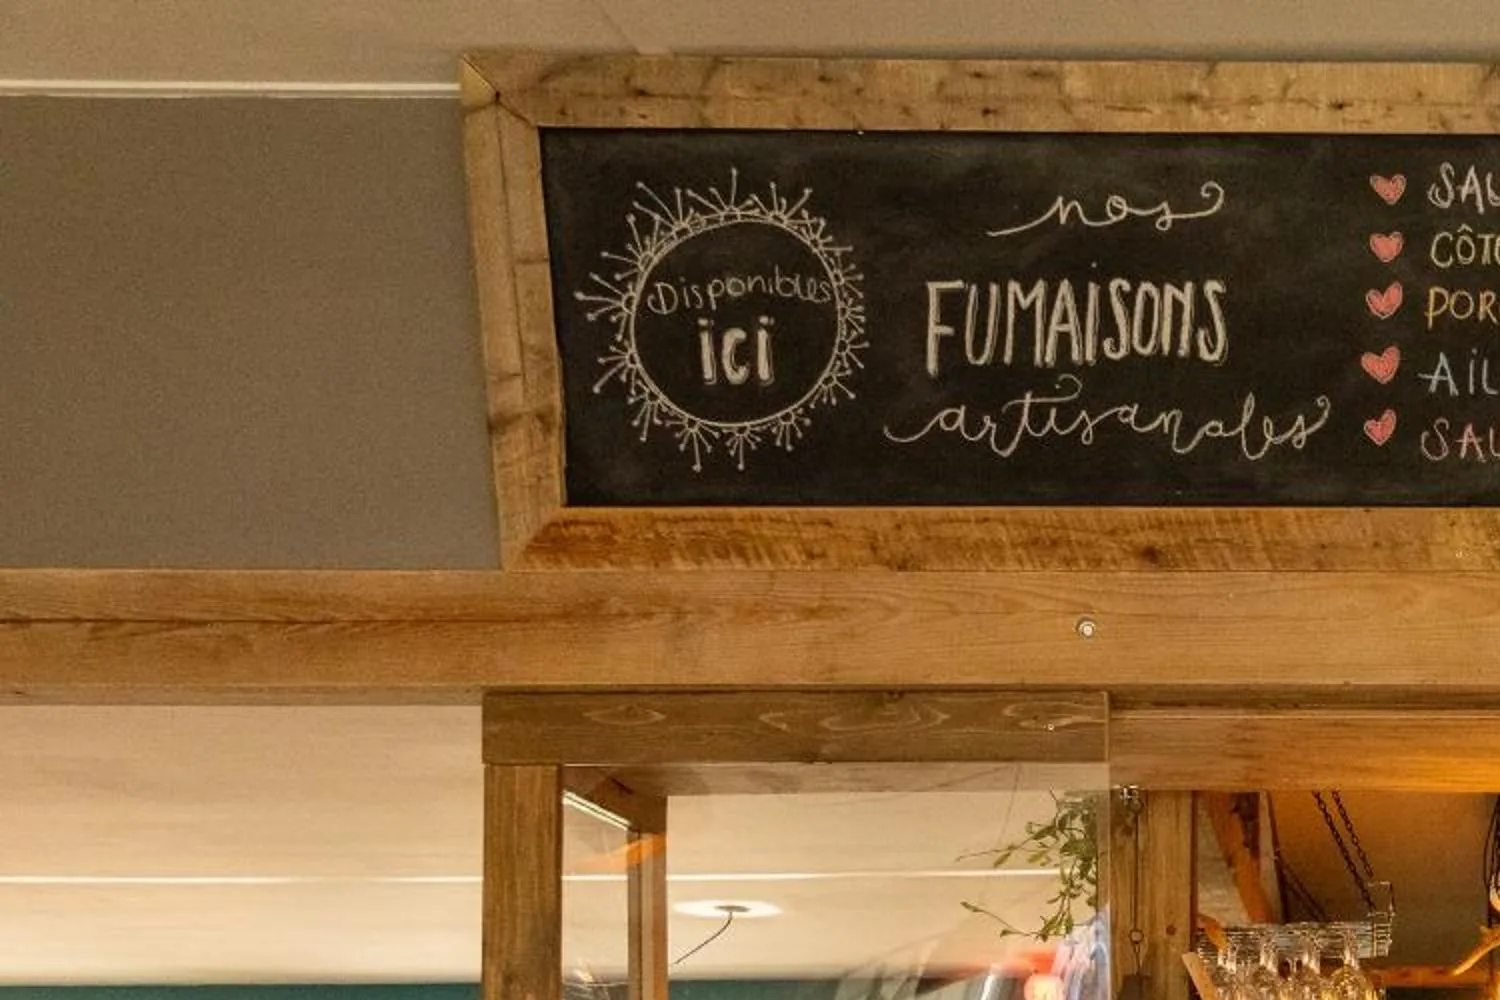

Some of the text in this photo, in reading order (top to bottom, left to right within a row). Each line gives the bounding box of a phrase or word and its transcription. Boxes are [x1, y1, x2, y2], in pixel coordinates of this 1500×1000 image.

[987, 181, 1225, 239] nos
[647, 264, 832, 315] Disponibles
[698, 316, 775, 386] ici
[884, 374, 1331, 460] artisanales
